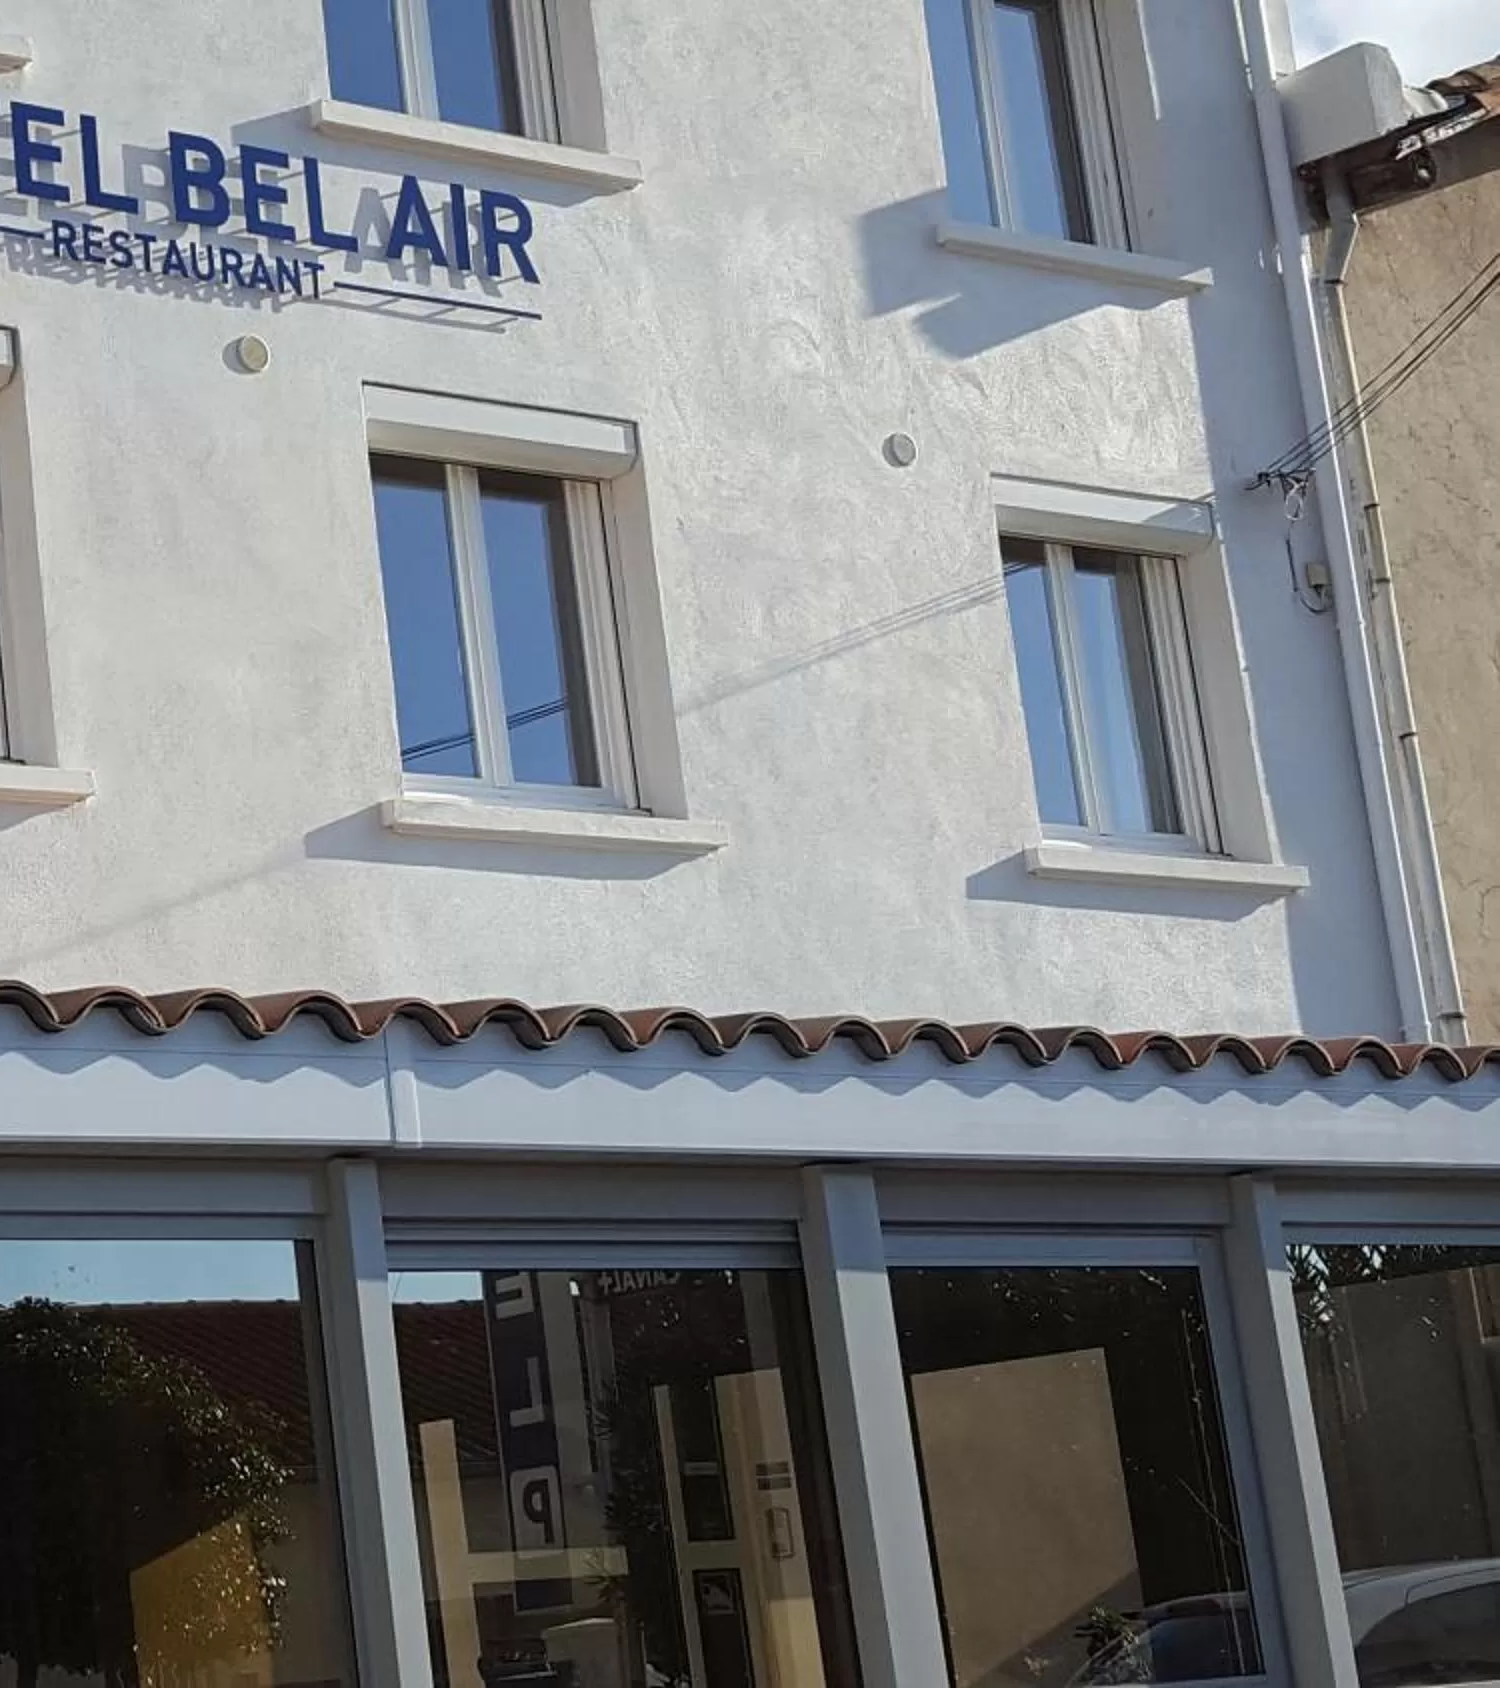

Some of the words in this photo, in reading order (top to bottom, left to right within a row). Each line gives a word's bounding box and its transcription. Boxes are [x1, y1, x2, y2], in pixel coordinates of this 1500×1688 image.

[51, 218, 324, 300] RESTAURANT
[167, 130, 359, 253] BEL
[383, 174, 542, 284] AIR
